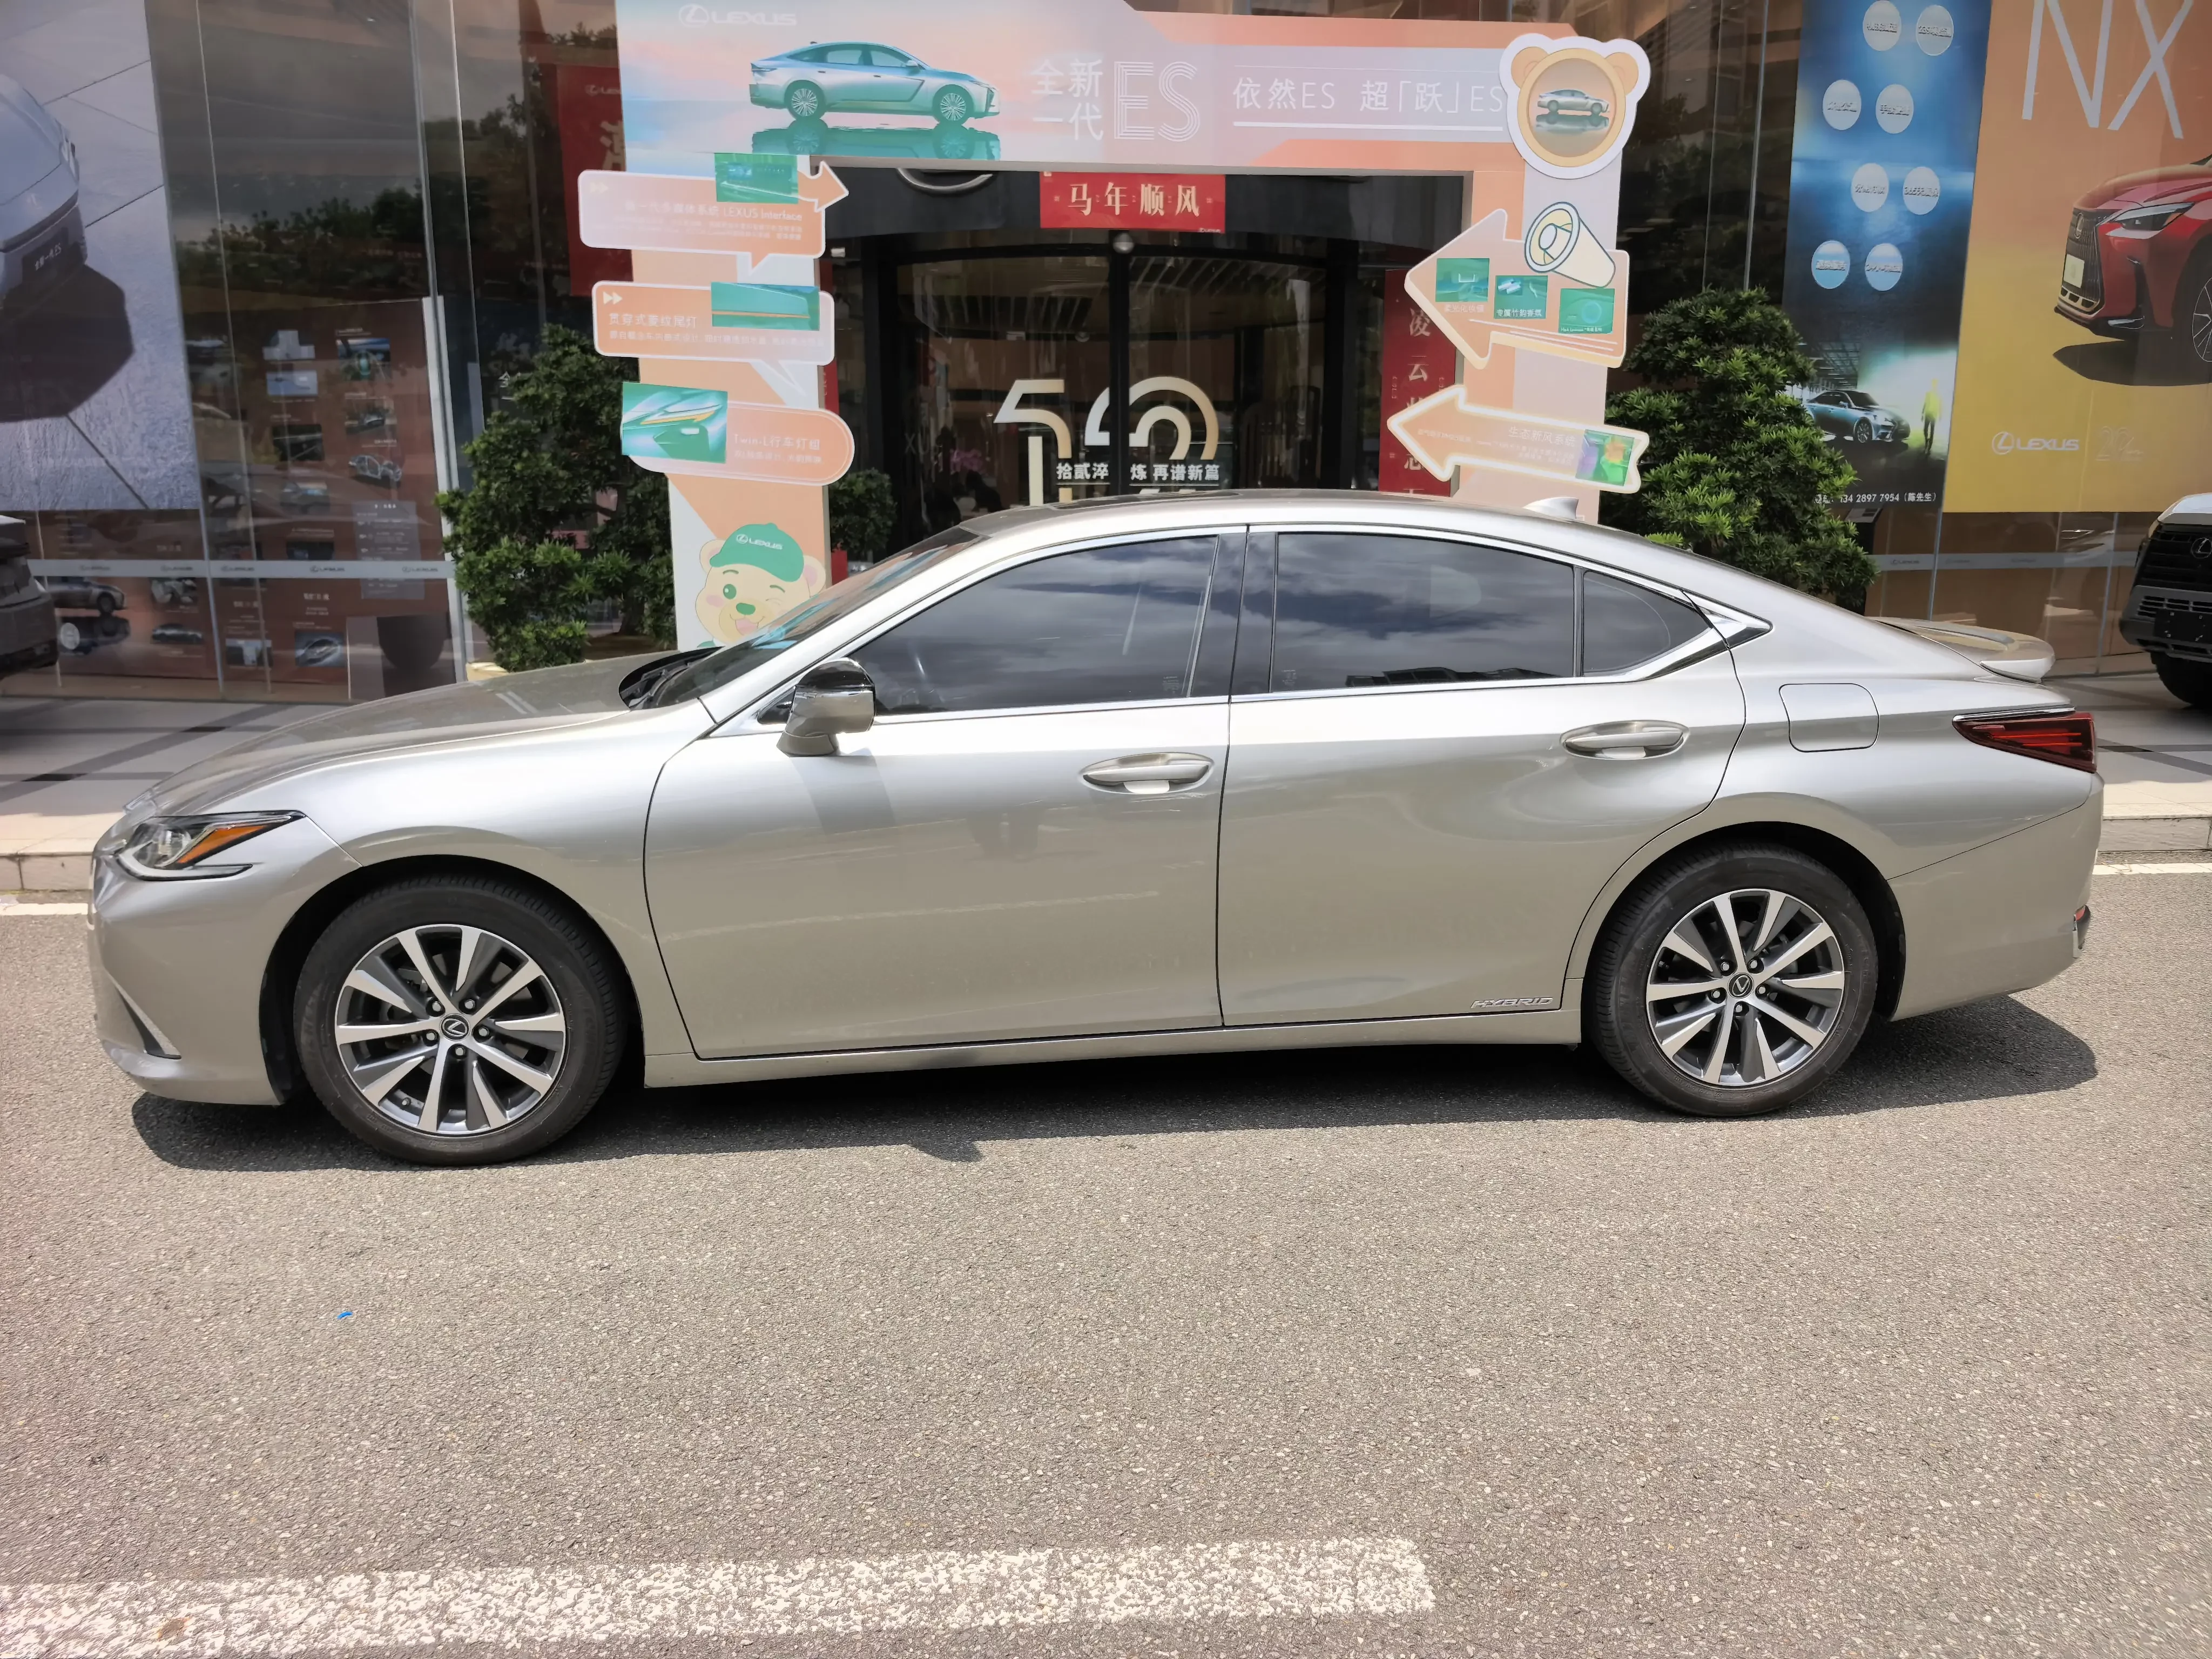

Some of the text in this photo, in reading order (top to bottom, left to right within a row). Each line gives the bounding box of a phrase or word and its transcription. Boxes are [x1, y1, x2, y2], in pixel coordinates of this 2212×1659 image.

[711, 11, 798, 25] LEXUS
[1030, 59, 1104, 97] 全新
[2022, 0, 2193, 139] NX
[1114, 60, 1201, 142] ES
[1232, 77, 1336, 110] 依然ES
[1031, 102, 1104, 141] 一代
[1067, 181, 1200, 217] 马年顺风
[724, 207, 758, 218] LEXUS
[1508, 426, 1576, 448] 生态新风系统
[2017, 438, 2080, 451] LEXUS
[1153, 464, 1220, 482] 再谱新篇
[1856, 494, 1877, 503] 2897
[1879, 493, 1899, 502] 7954
[1471, 997, 1553, 1009] HYBRID
